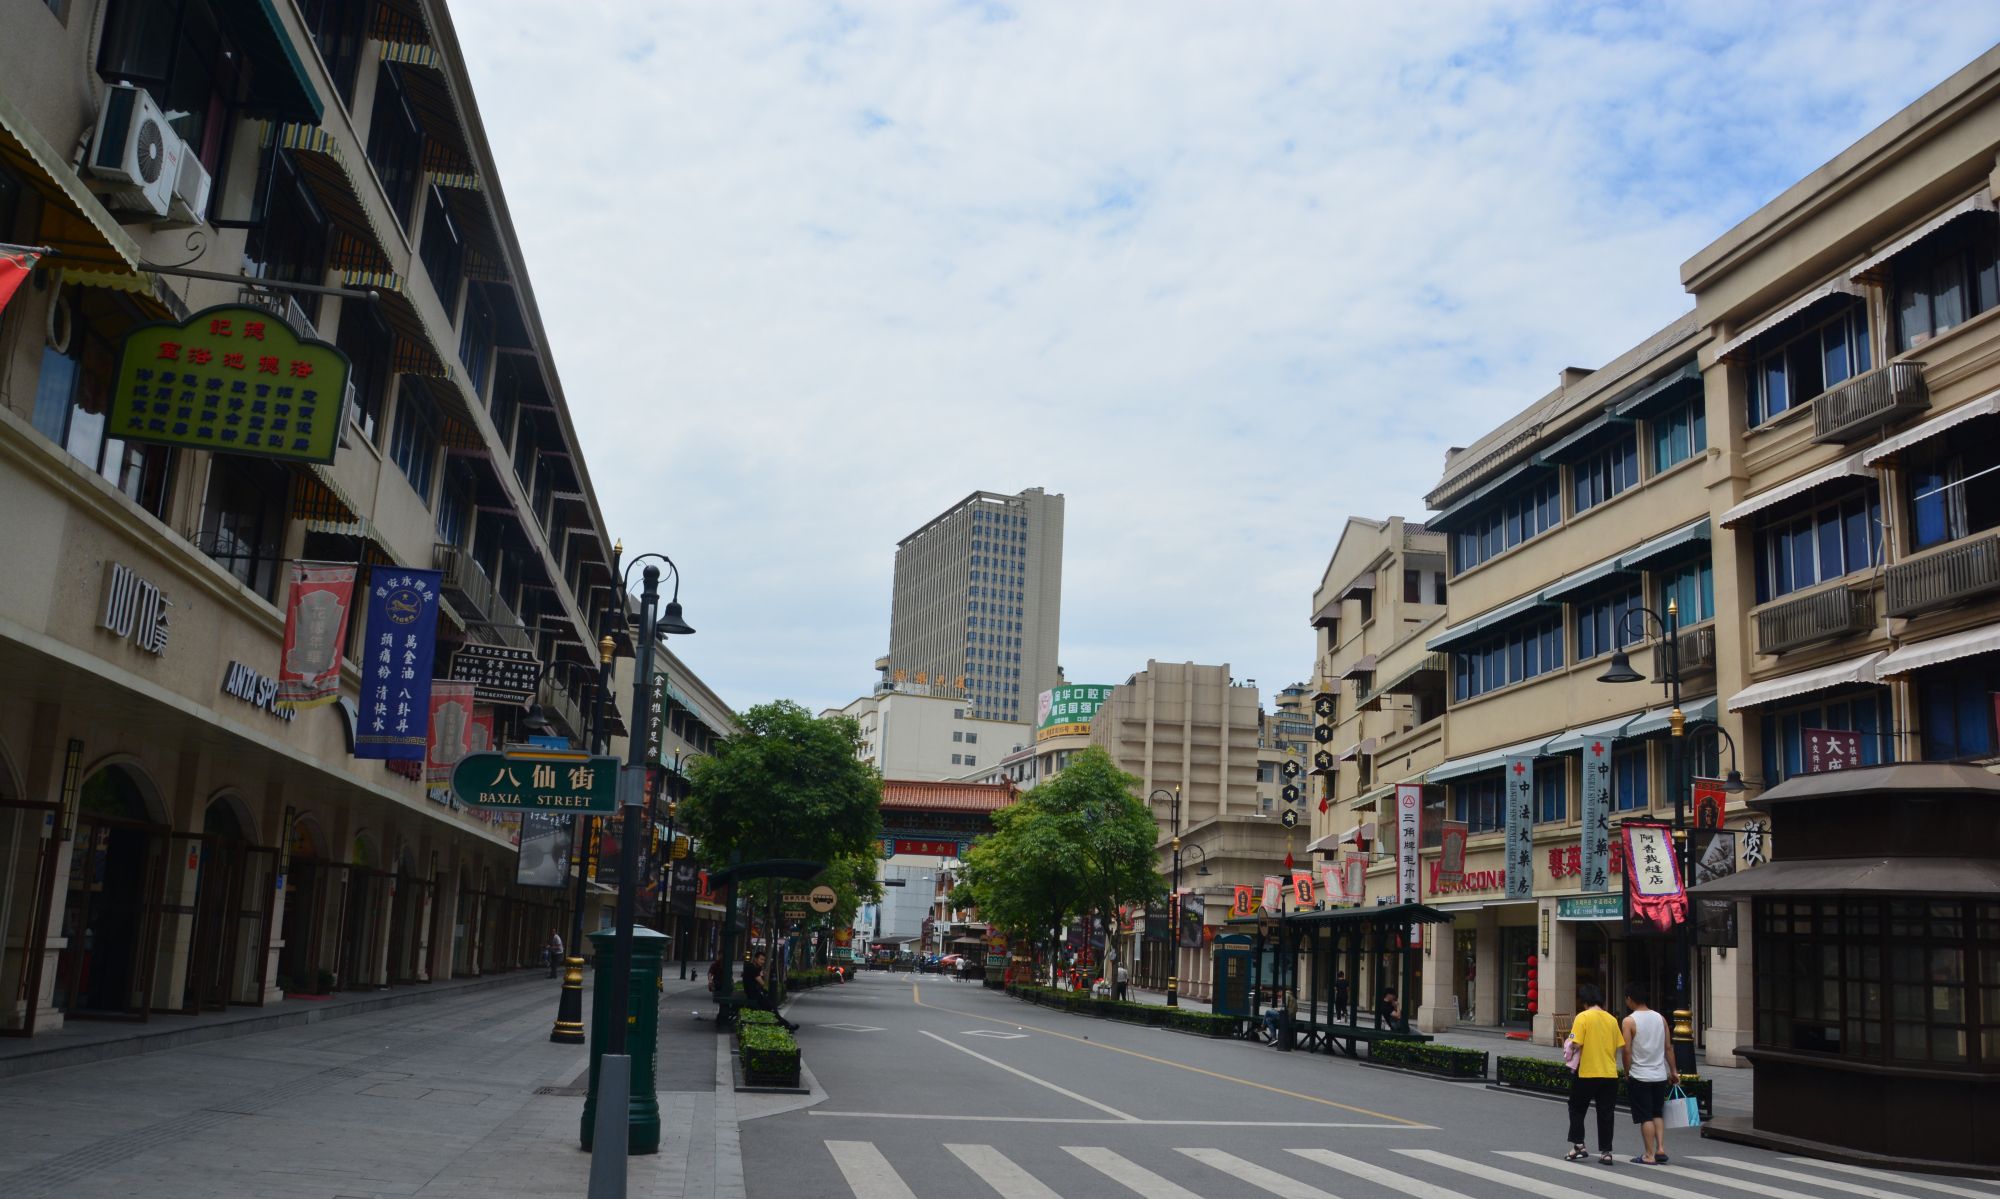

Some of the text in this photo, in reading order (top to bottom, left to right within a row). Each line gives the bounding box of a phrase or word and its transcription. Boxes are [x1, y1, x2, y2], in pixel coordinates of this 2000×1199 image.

[391, 613, 417, 623] TIGER
[377, 633, 393, 680] 頭痛粉
[401, 635, 418, 681] 萬金油
[226, 661, 258, 703] ANTA
[490, 763, 596, 791] 八仙街
[479, 791, 593, 808] BAXIA STREET
